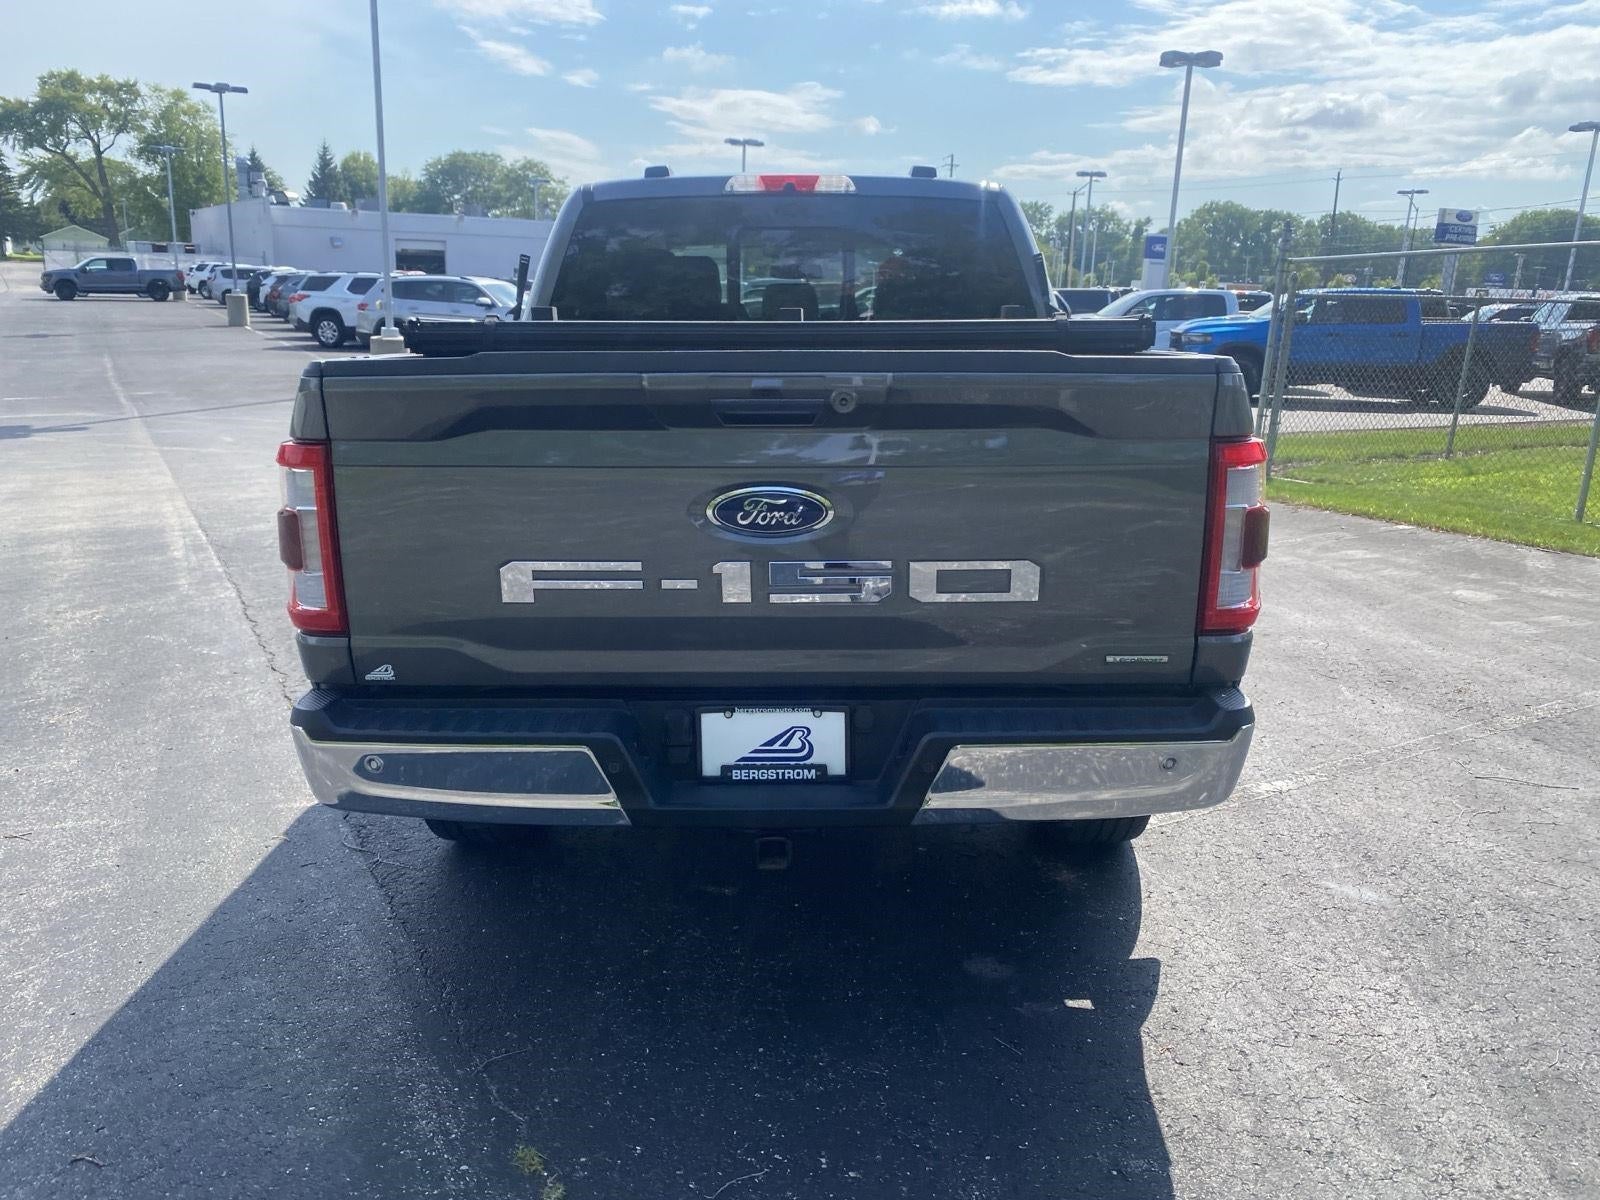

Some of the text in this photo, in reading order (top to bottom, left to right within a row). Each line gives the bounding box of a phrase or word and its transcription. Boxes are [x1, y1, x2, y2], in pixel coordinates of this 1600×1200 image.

[737, 498, 803, 525] Ford
[500, 561, 1041, 604] F-150
[732, 769, 816, 780] BERGSTROM
